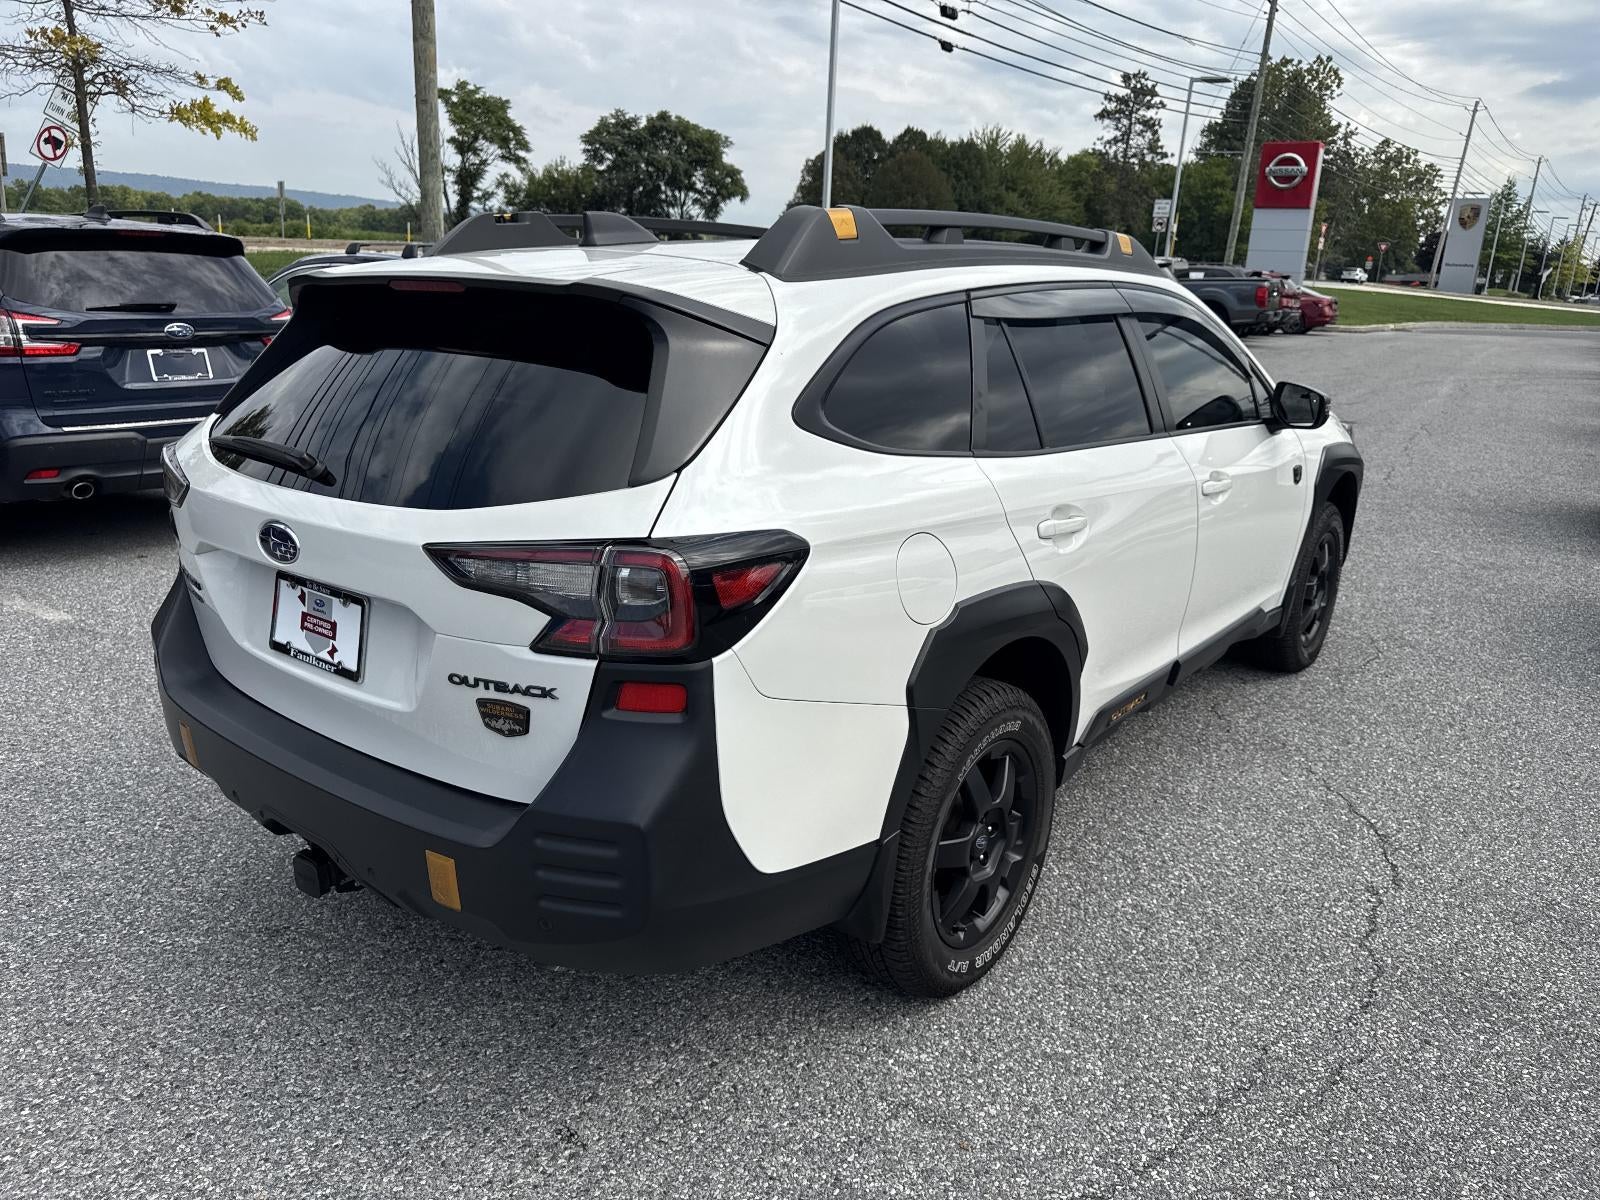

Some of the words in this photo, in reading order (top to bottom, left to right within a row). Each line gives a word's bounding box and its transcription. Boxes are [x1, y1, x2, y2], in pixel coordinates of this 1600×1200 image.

[48, 101, 66, 116] TURN
[1268, 166, 1304, 177] NISSAN
[304, 621, 333, 637] PRE-OWNED
[306, 616, 332, 630] CERTIFIED
[289, 647, 338, 673] Faulkner
[447, 672, 559, 700] OUTBACK
[480, 706, 525, 720] WILDERNESS
[486, 703, 515, 713] SUBARU
[975, 863, 1039, 968] GEOLANDAR
[947, 960, 970, 973] A/T
